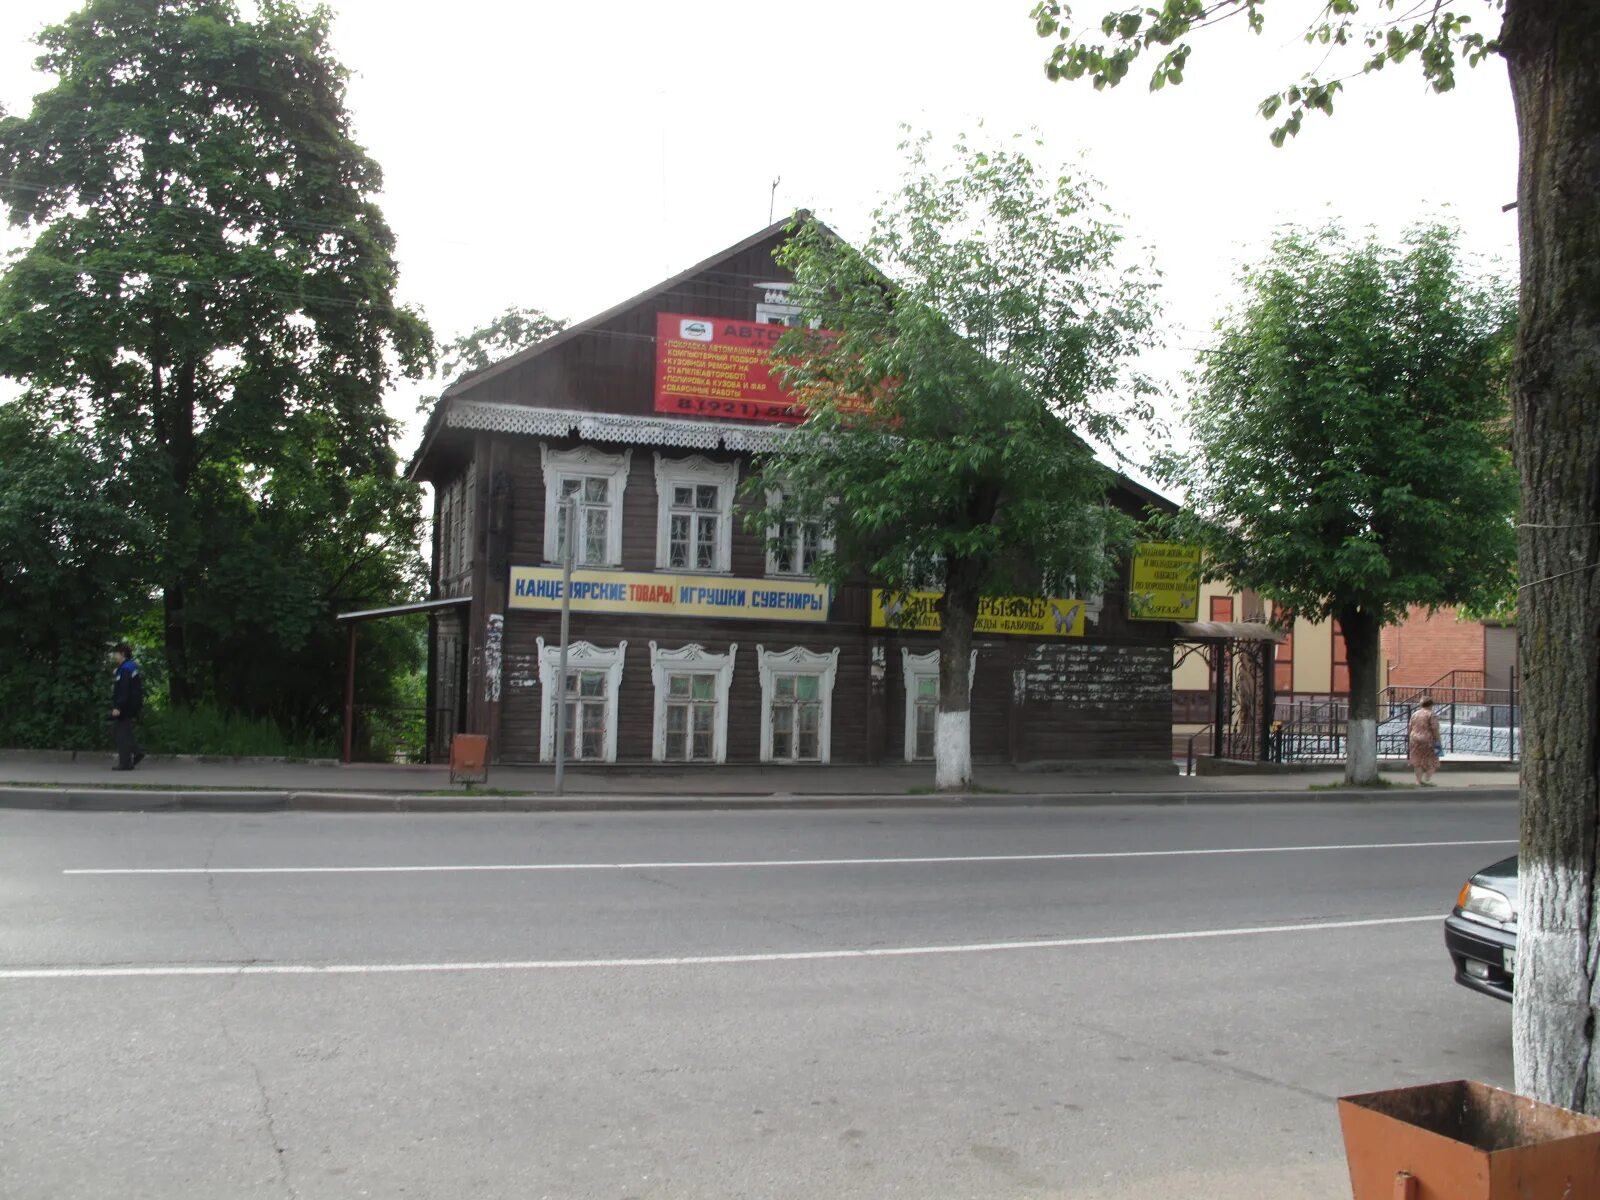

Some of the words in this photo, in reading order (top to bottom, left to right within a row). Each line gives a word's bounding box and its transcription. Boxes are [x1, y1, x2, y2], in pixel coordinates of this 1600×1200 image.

[707, 362, 737, 371] РЕМОНТ
[712, 379, 741, 388] КУЗОВА
[711, 388, 741, 397] РАБОТЫ
[752, 590, 823, 611] СУВЕНИРЫ
